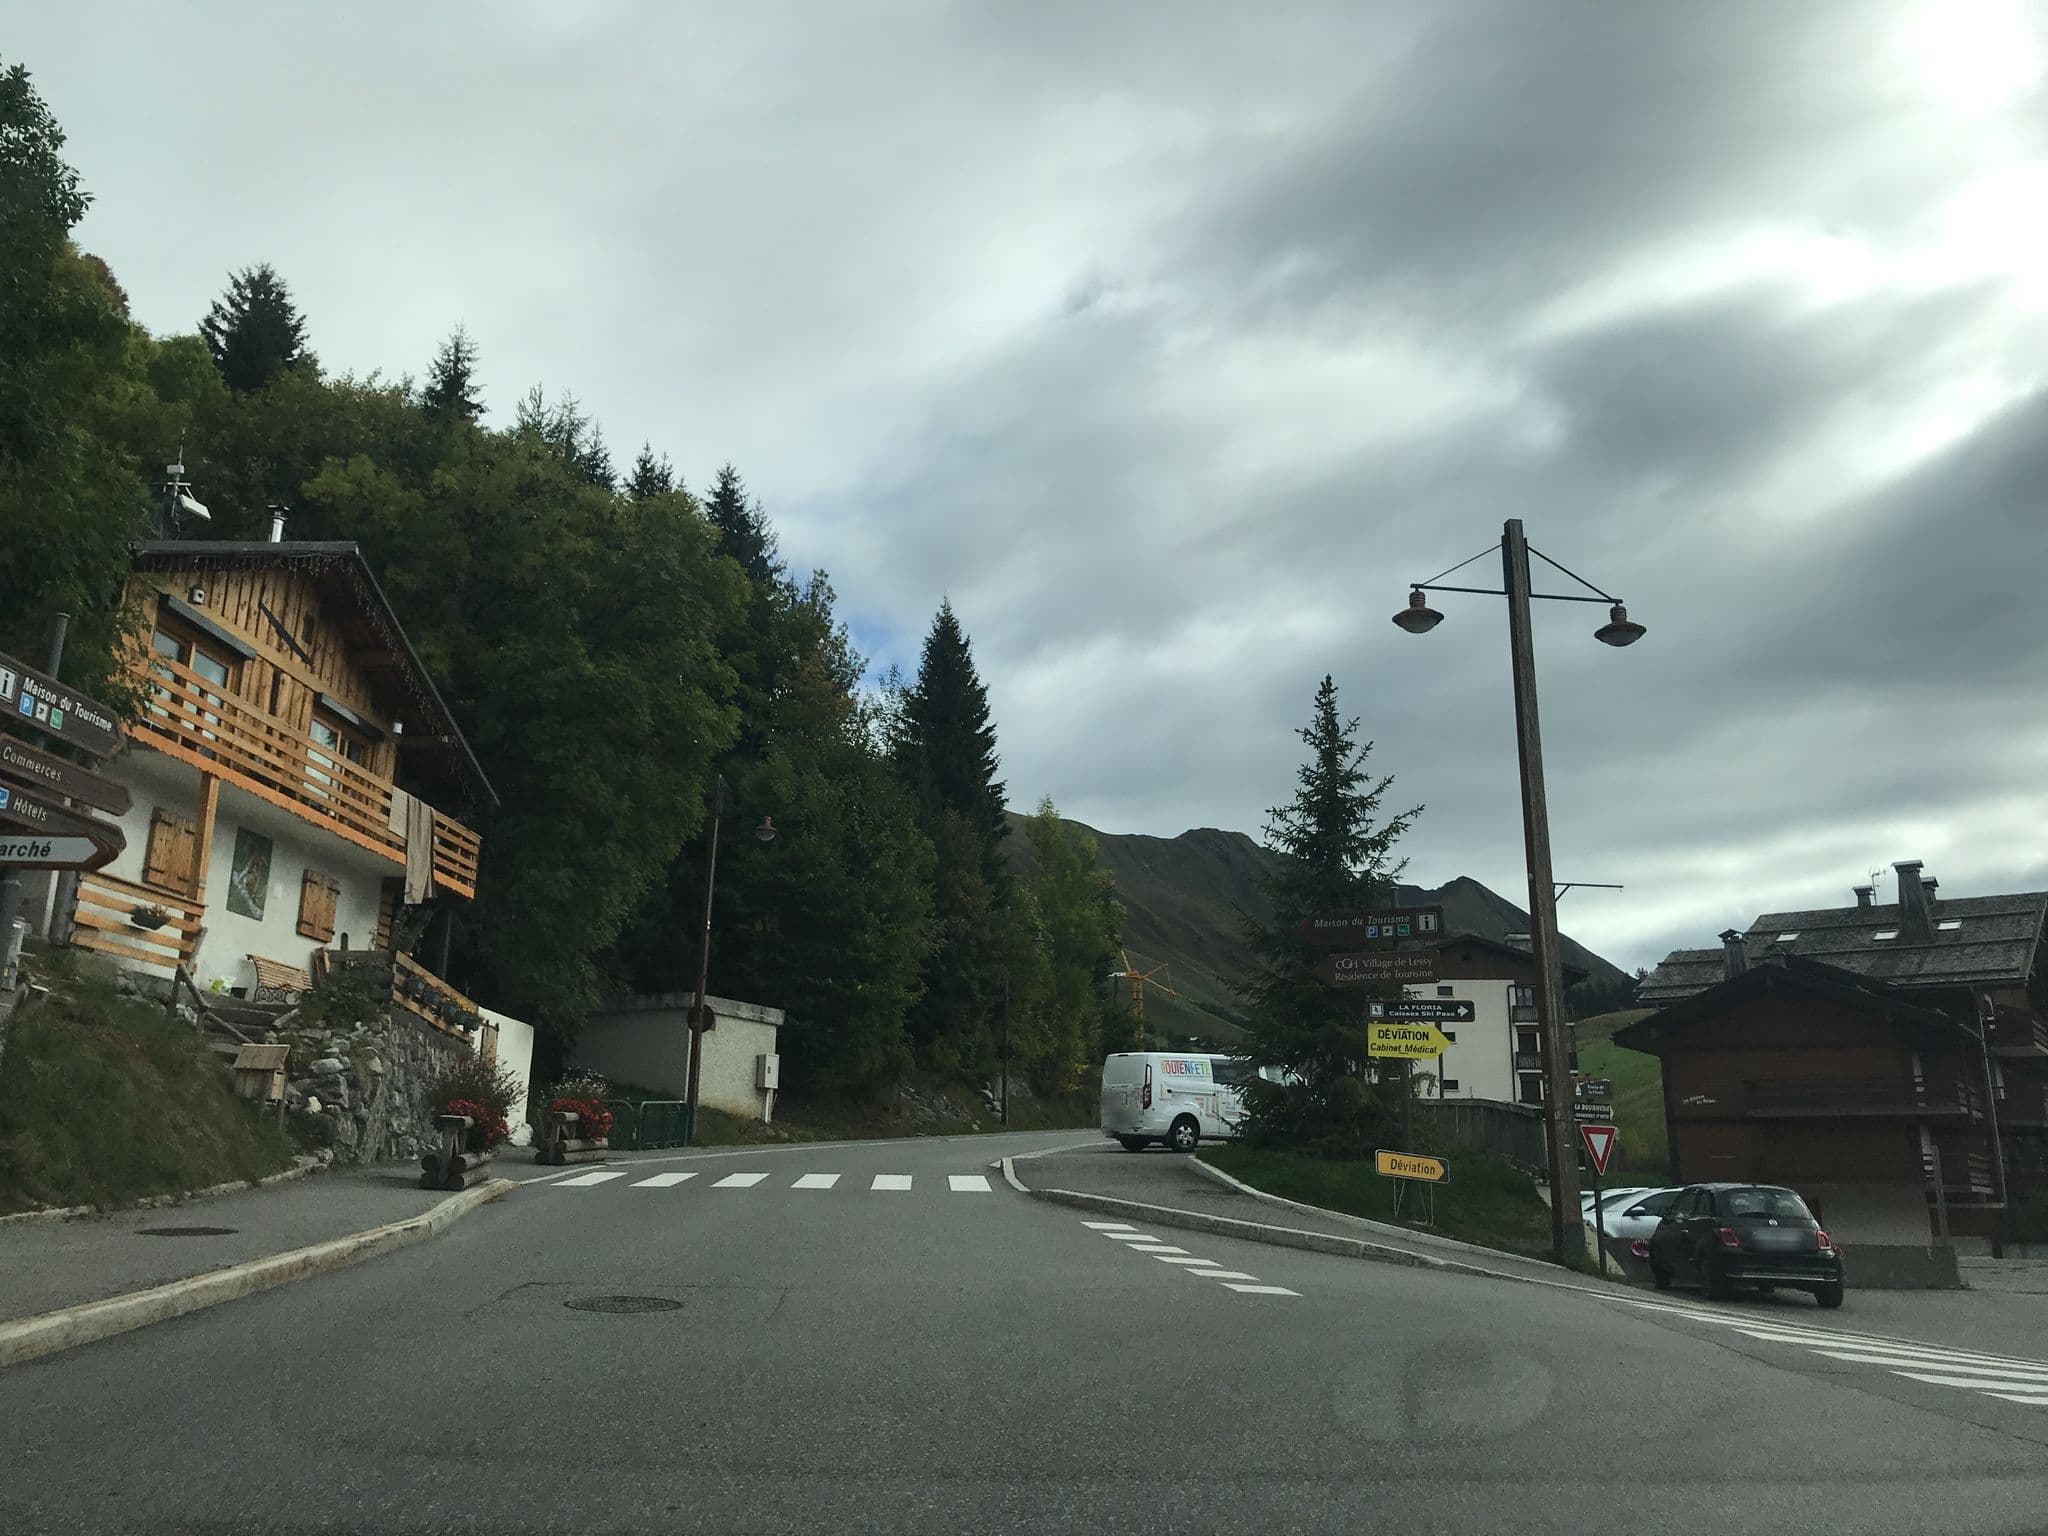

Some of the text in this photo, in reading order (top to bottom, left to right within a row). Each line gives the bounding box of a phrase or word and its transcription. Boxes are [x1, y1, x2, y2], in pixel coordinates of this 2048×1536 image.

[22, 676, 113, 732] Maison du Tourisme
[3, 746, 62, 782] Commerces
[13, 797, 48, 822] Hôtels
[0, 841, 51, 858] arché
[1314, 915, 1410, 928] Maison du Tourisme
[1335, 957, 1433, 969] CGH Village de Lessy
[1380, 970, 1392, 979] de
[1393, 969, 1433, 979] Tourisme
[1377, 1028, 1430, 1041] DÉVIATION
[1370, 1043, 1437, 1054] Cabinet Médical
[1390, 1158, 1436, 1175] Déviation
